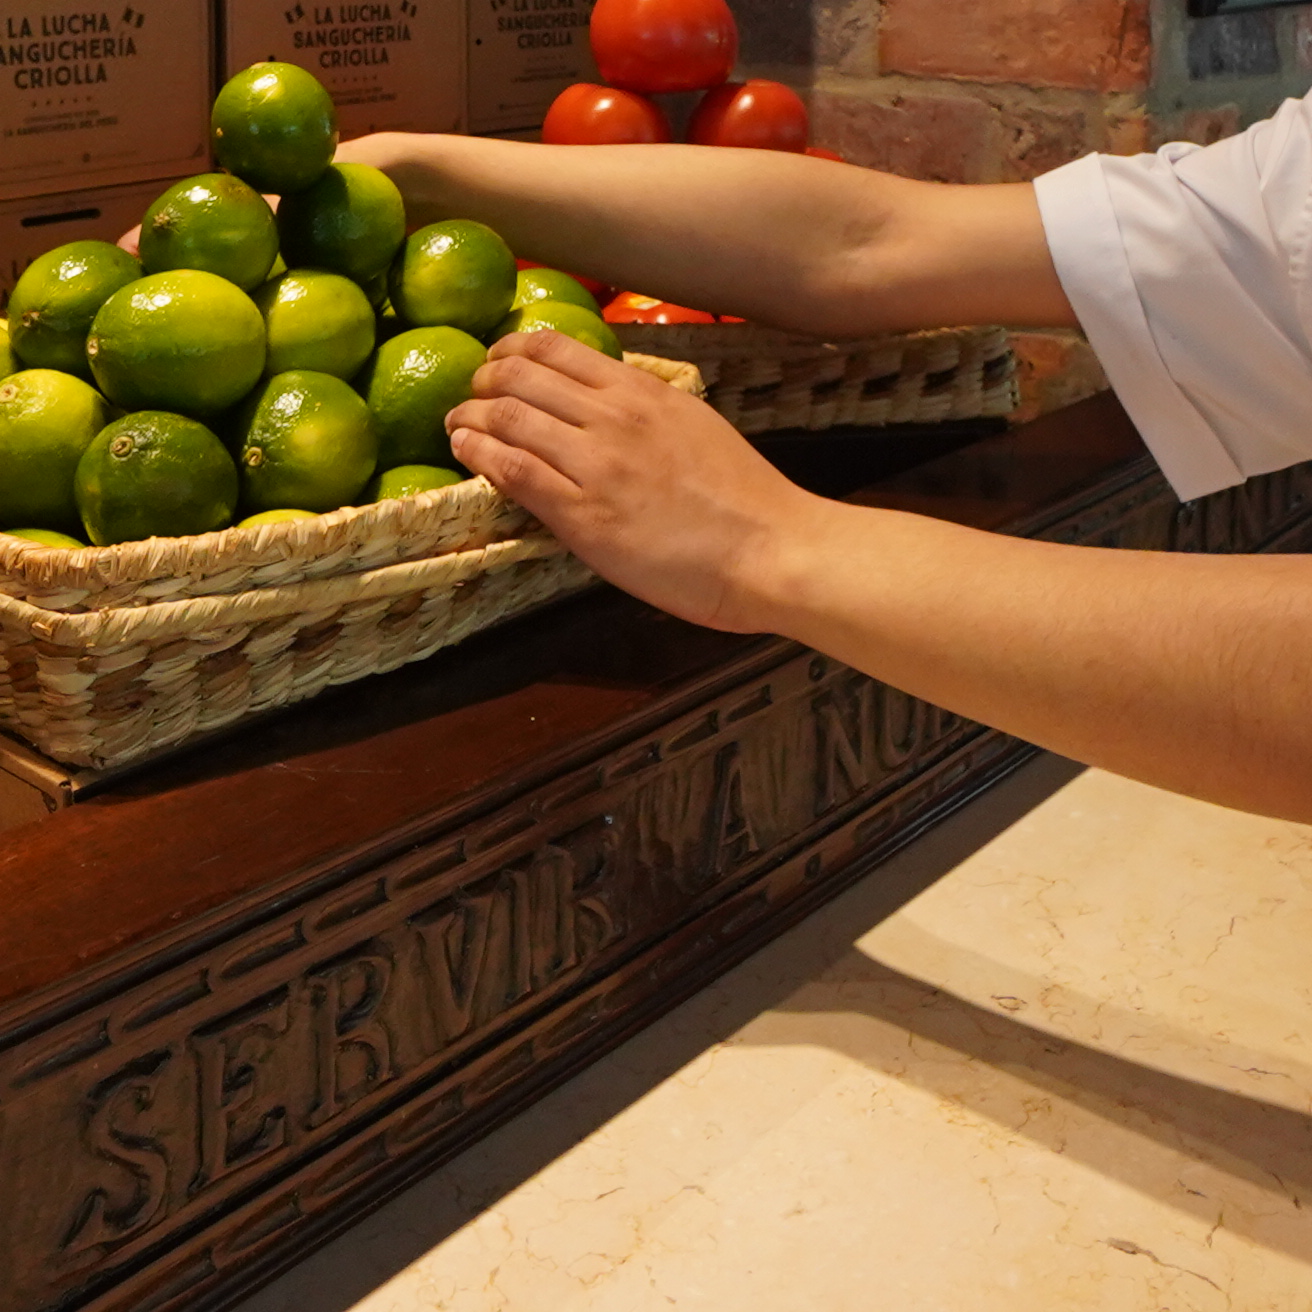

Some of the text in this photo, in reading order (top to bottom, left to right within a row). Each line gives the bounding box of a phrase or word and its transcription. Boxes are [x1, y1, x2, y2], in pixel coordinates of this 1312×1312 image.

[7, 13, 110, 38] LA LUCHA
[314, 4, 392, 25] LA LUCHA
[293, 21, 411, 49] SANGUCHERÍA
[319, 47, 389, 68] CRIOLLA
[14, 63, 107, 89] CRIOLLA
